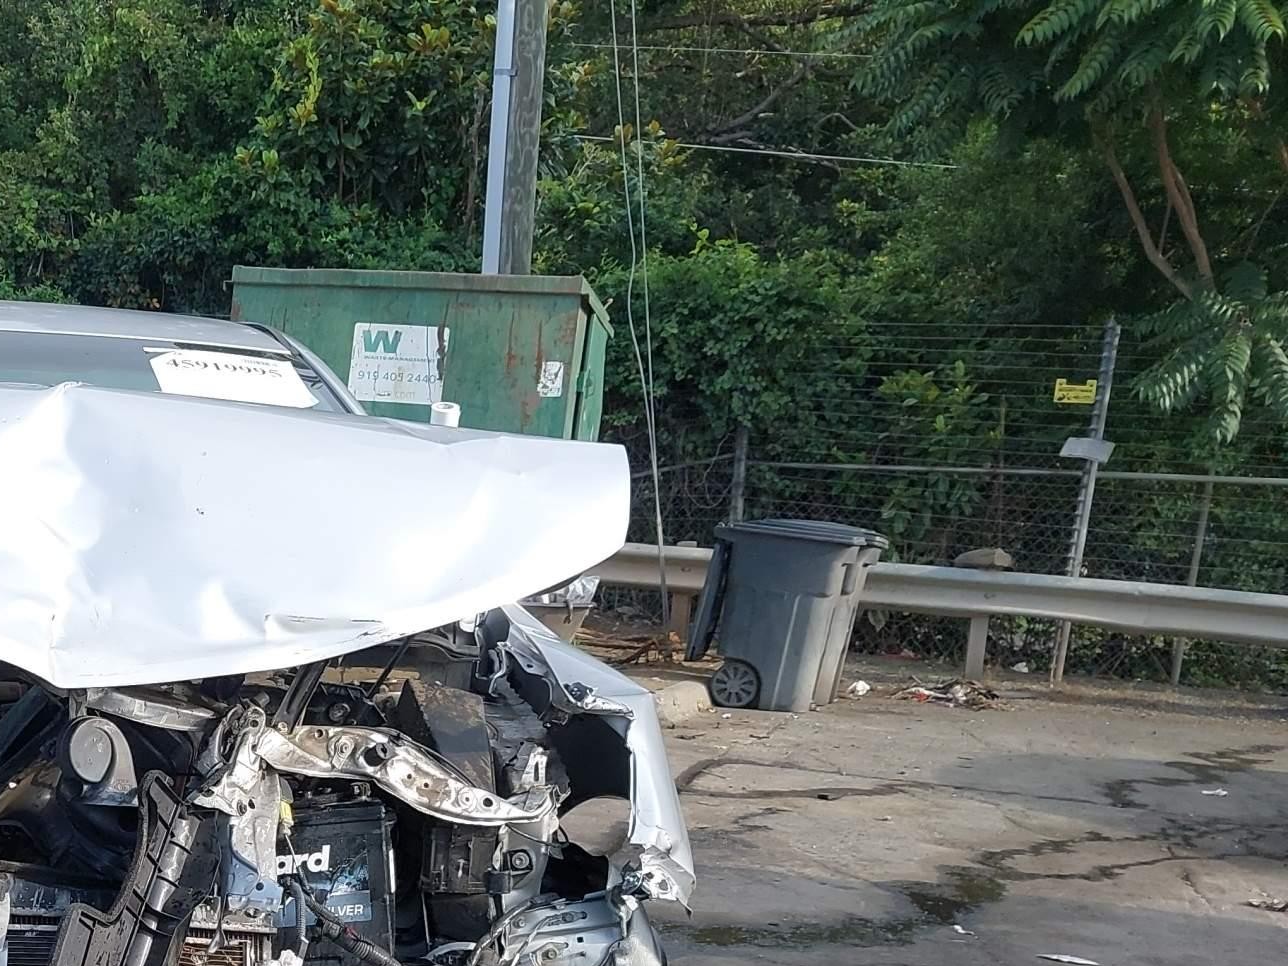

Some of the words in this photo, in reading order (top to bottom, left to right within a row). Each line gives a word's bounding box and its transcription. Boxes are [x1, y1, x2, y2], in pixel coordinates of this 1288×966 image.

[363, 330, 402, 354] W
[166, 358, 283, 378] 45919995
[358, 370, 379, 380] 919
[407, 373, 436, 384] 2440
